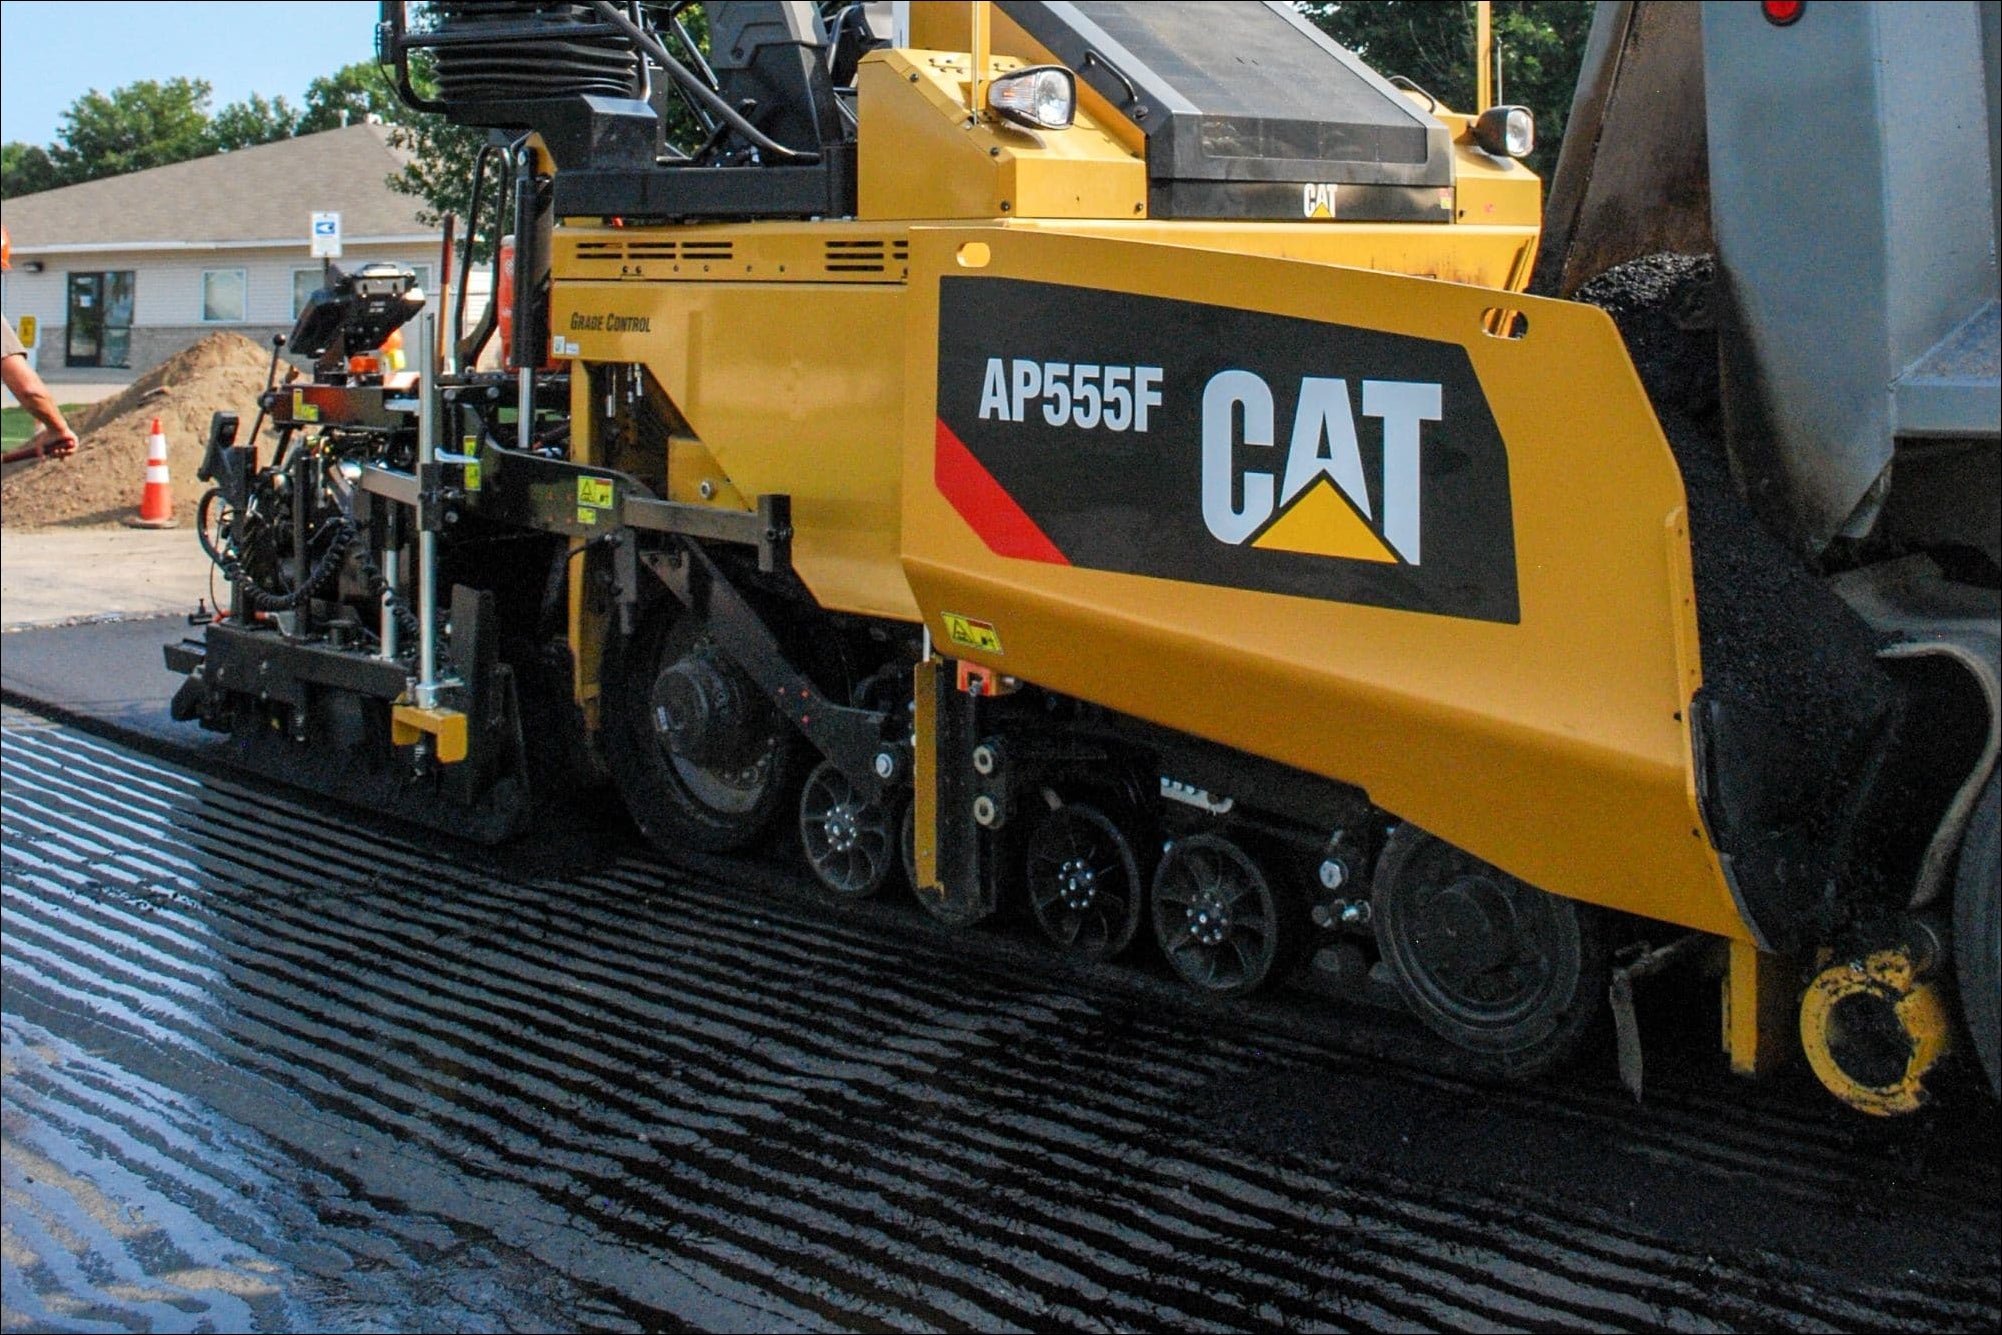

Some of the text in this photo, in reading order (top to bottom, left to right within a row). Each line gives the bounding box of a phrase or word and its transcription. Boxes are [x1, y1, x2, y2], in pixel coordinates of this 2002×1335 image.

[1303, 183, 1338, 218] CAT
[606, 313, 651, 332] CONTROL
[978, 357, 1163, 432] AP555F
[1202, 369, 1442, 566] CAT
